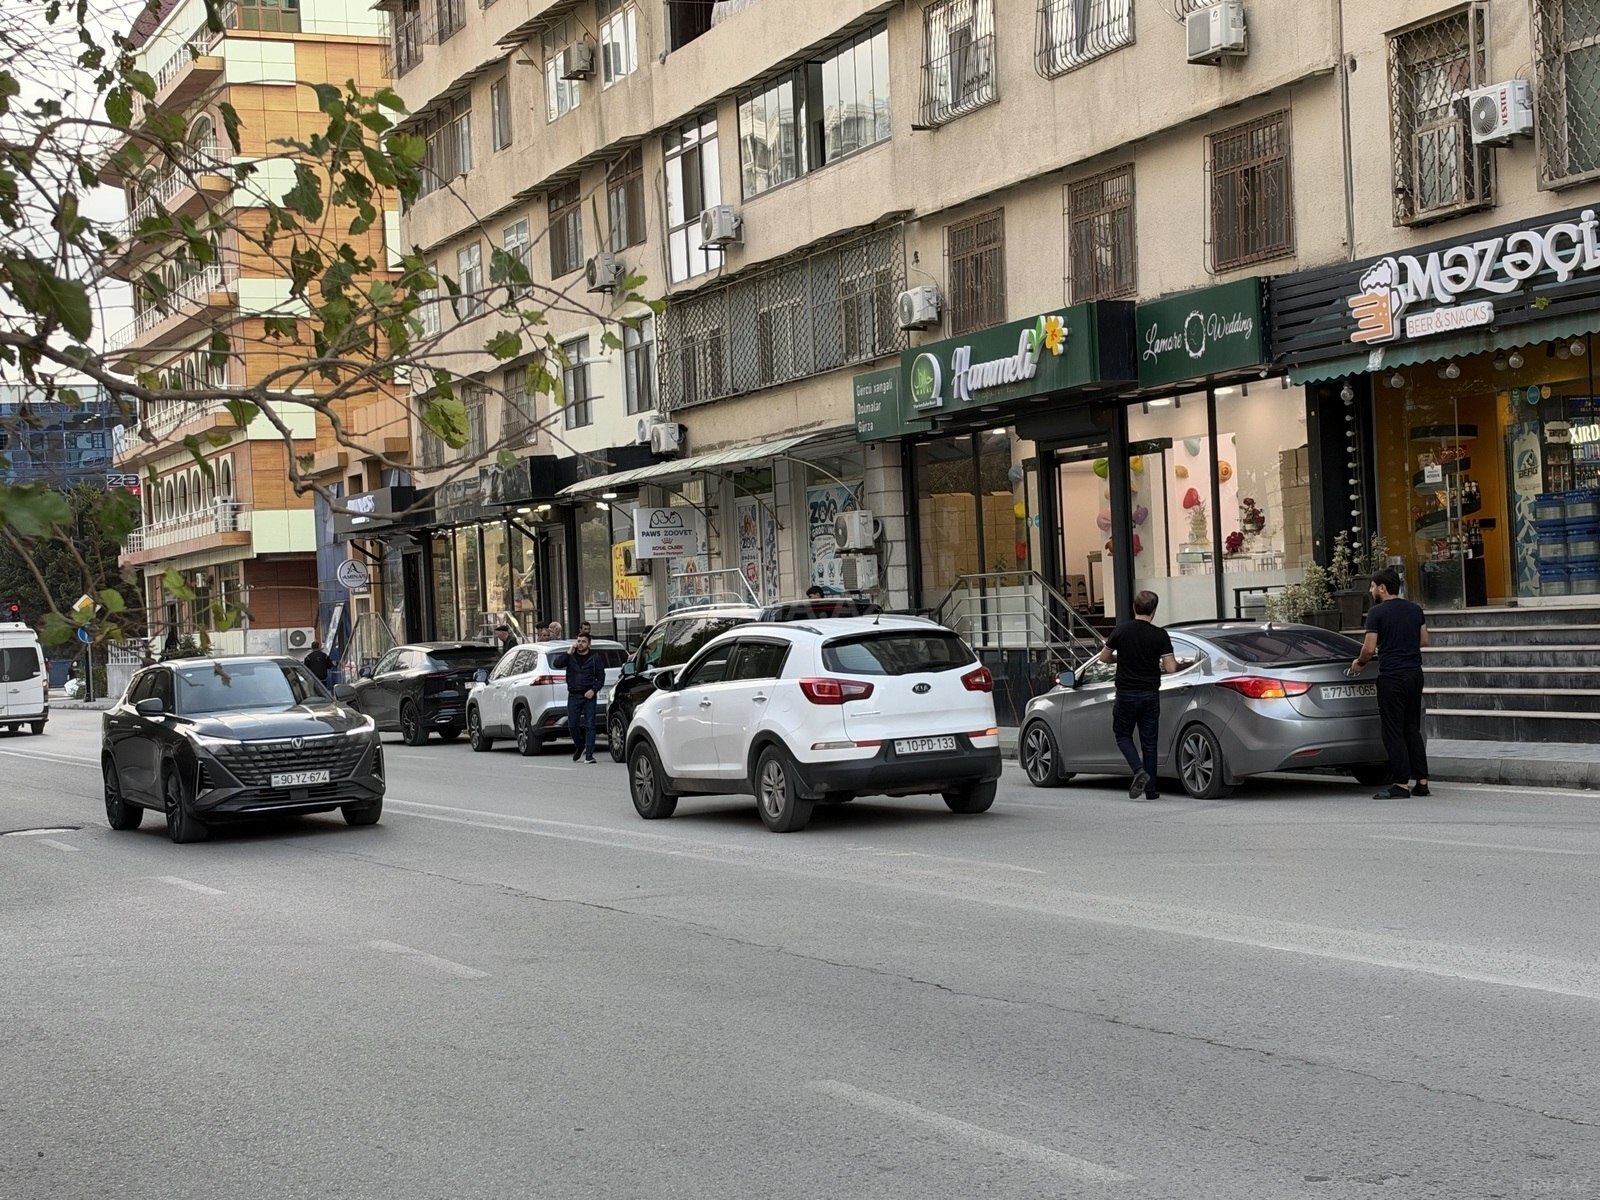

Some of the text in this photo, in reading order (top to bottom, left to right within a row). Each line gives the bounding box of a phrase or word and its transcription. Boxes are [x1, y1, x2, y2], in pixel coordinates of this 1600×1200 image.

[1500, 88, 1508, 126] VESTEL
[1206, 312, 1253, 341] Wedding
[1408, 306, 1487, 335] BEER & SNACKS
[906, 737, 955, 752] 10-PD-133
[280, 771, 328, 785] 90-YZ-674
